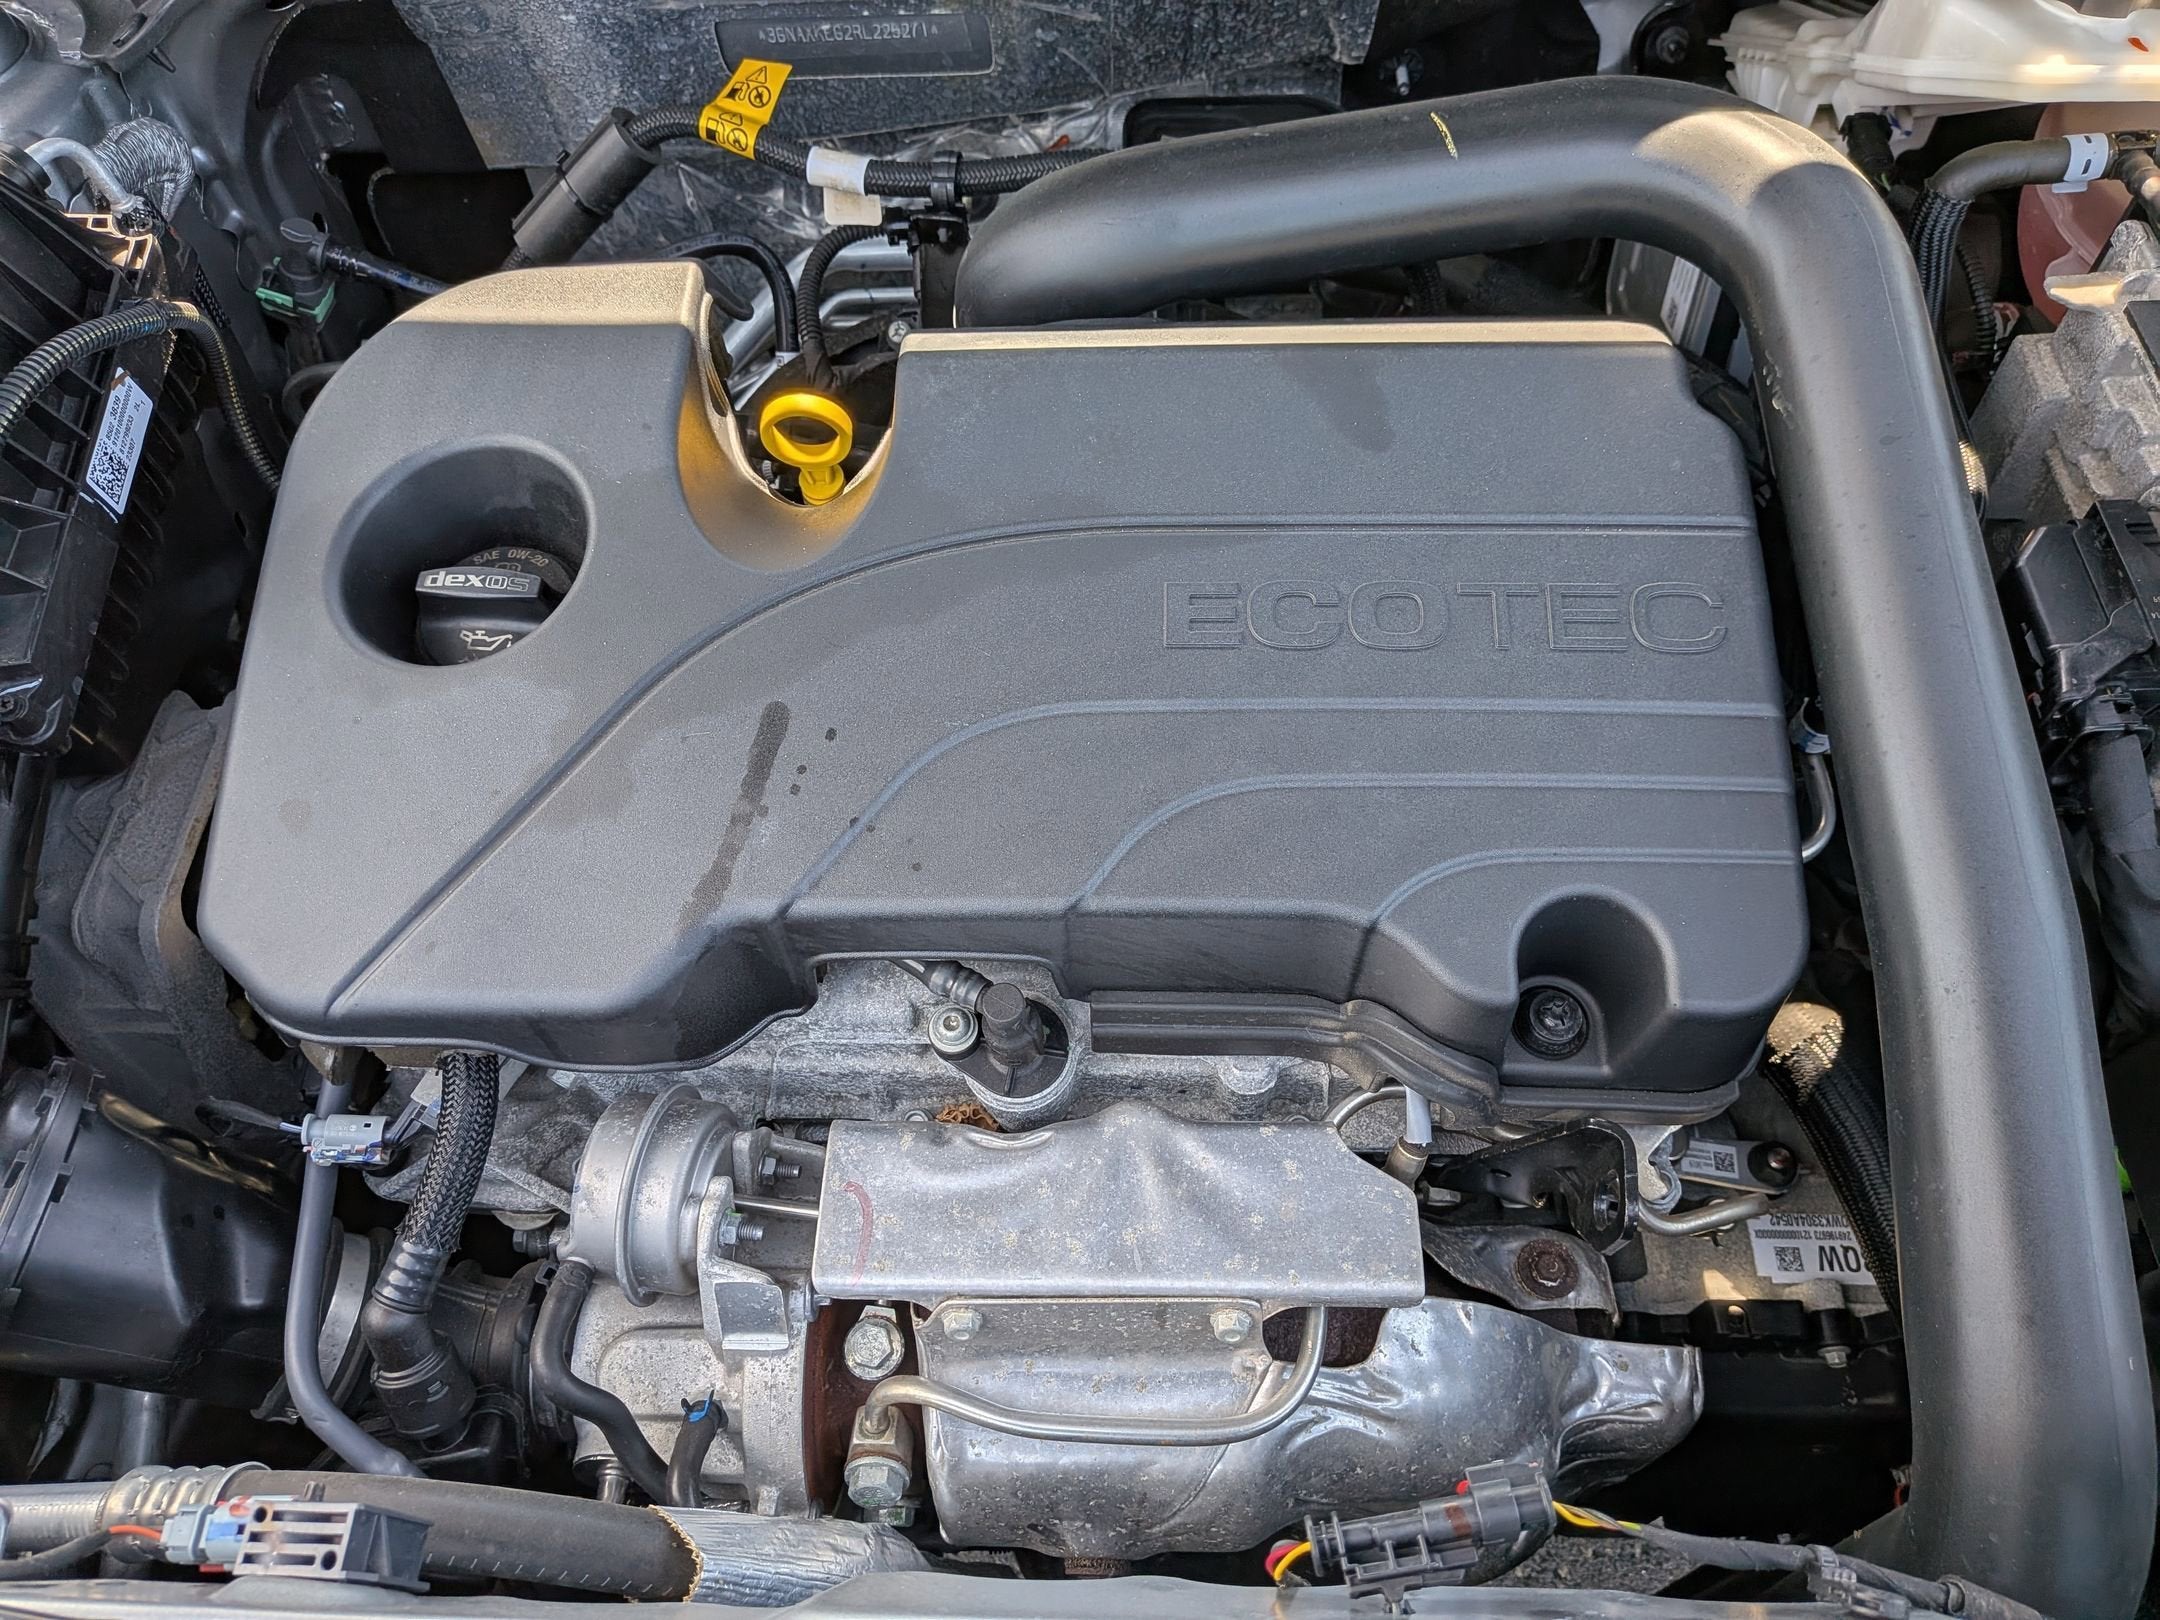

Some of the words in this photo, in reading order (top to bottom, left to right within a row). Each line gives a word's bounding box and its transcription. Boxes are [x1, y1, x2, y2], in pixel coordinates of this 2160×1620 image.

[472, 550, 501, 565] SAE
[507, 549, 550, 568] 0W-20
[423, 570, 530, 592] dexos
[1163, 580, 1728, 653] ECOTEC
[1818, 1244, 1871, 1273] QW
